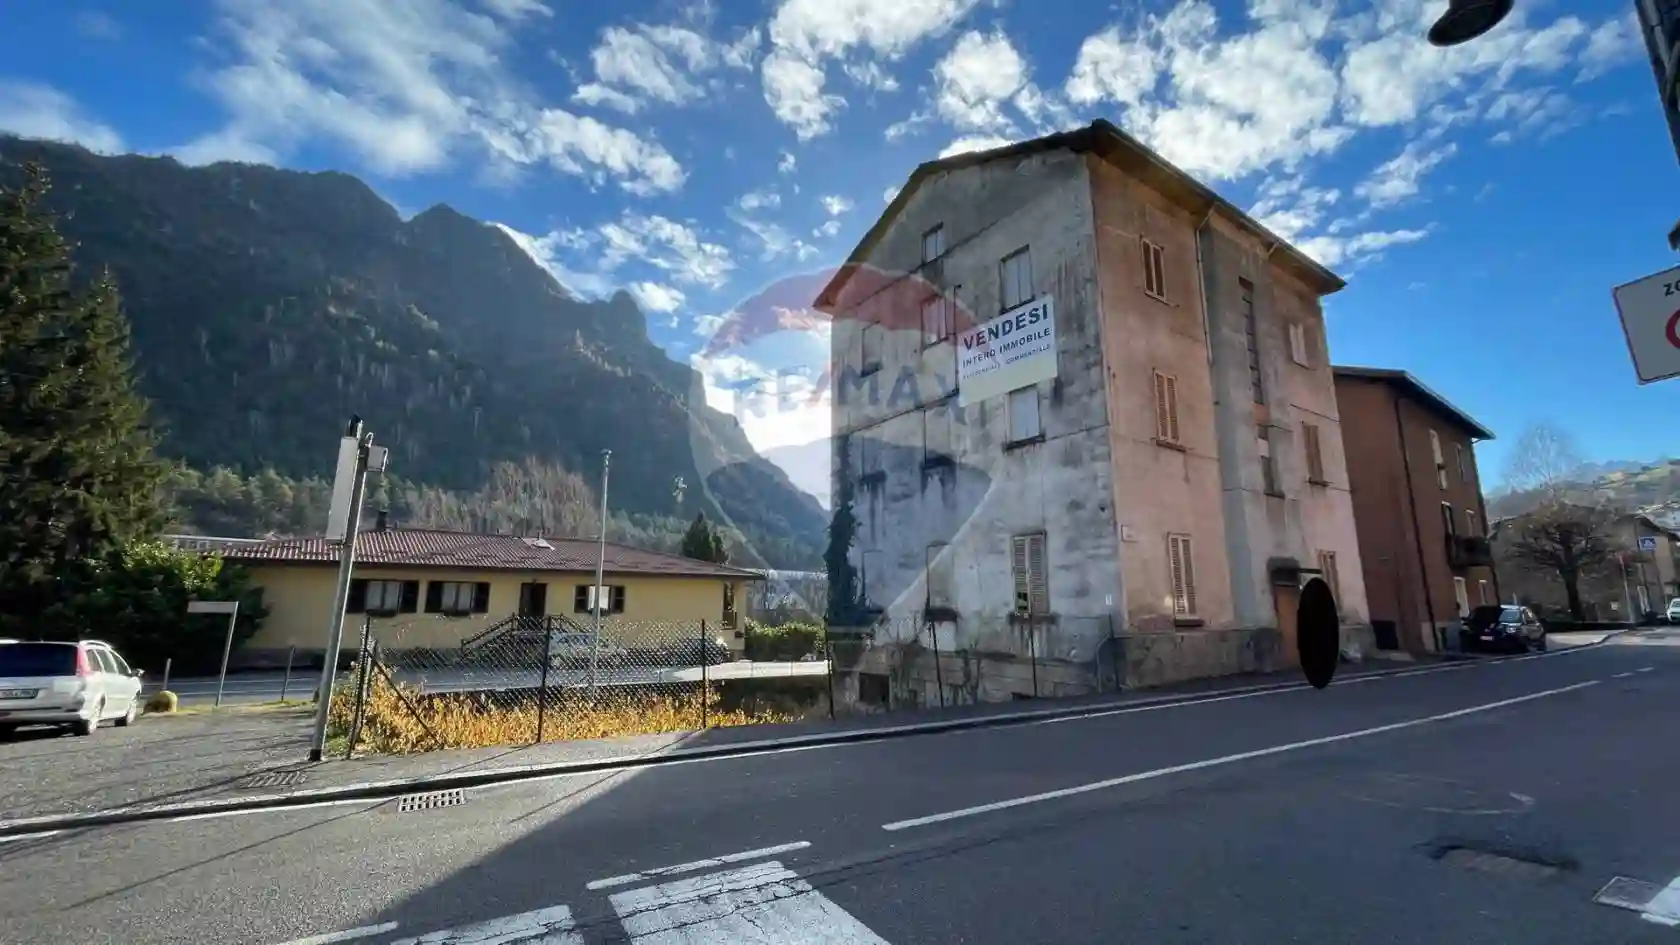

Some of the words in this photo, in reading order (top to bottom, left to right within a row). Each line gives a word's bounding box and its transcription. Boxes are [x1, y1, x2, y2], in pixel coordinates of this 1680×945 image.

[962, 347, 996, 369] INTERO
[999, 327, 1051, 354] IMMOBILE
[963, 303, 1048, 351] VENDESI
